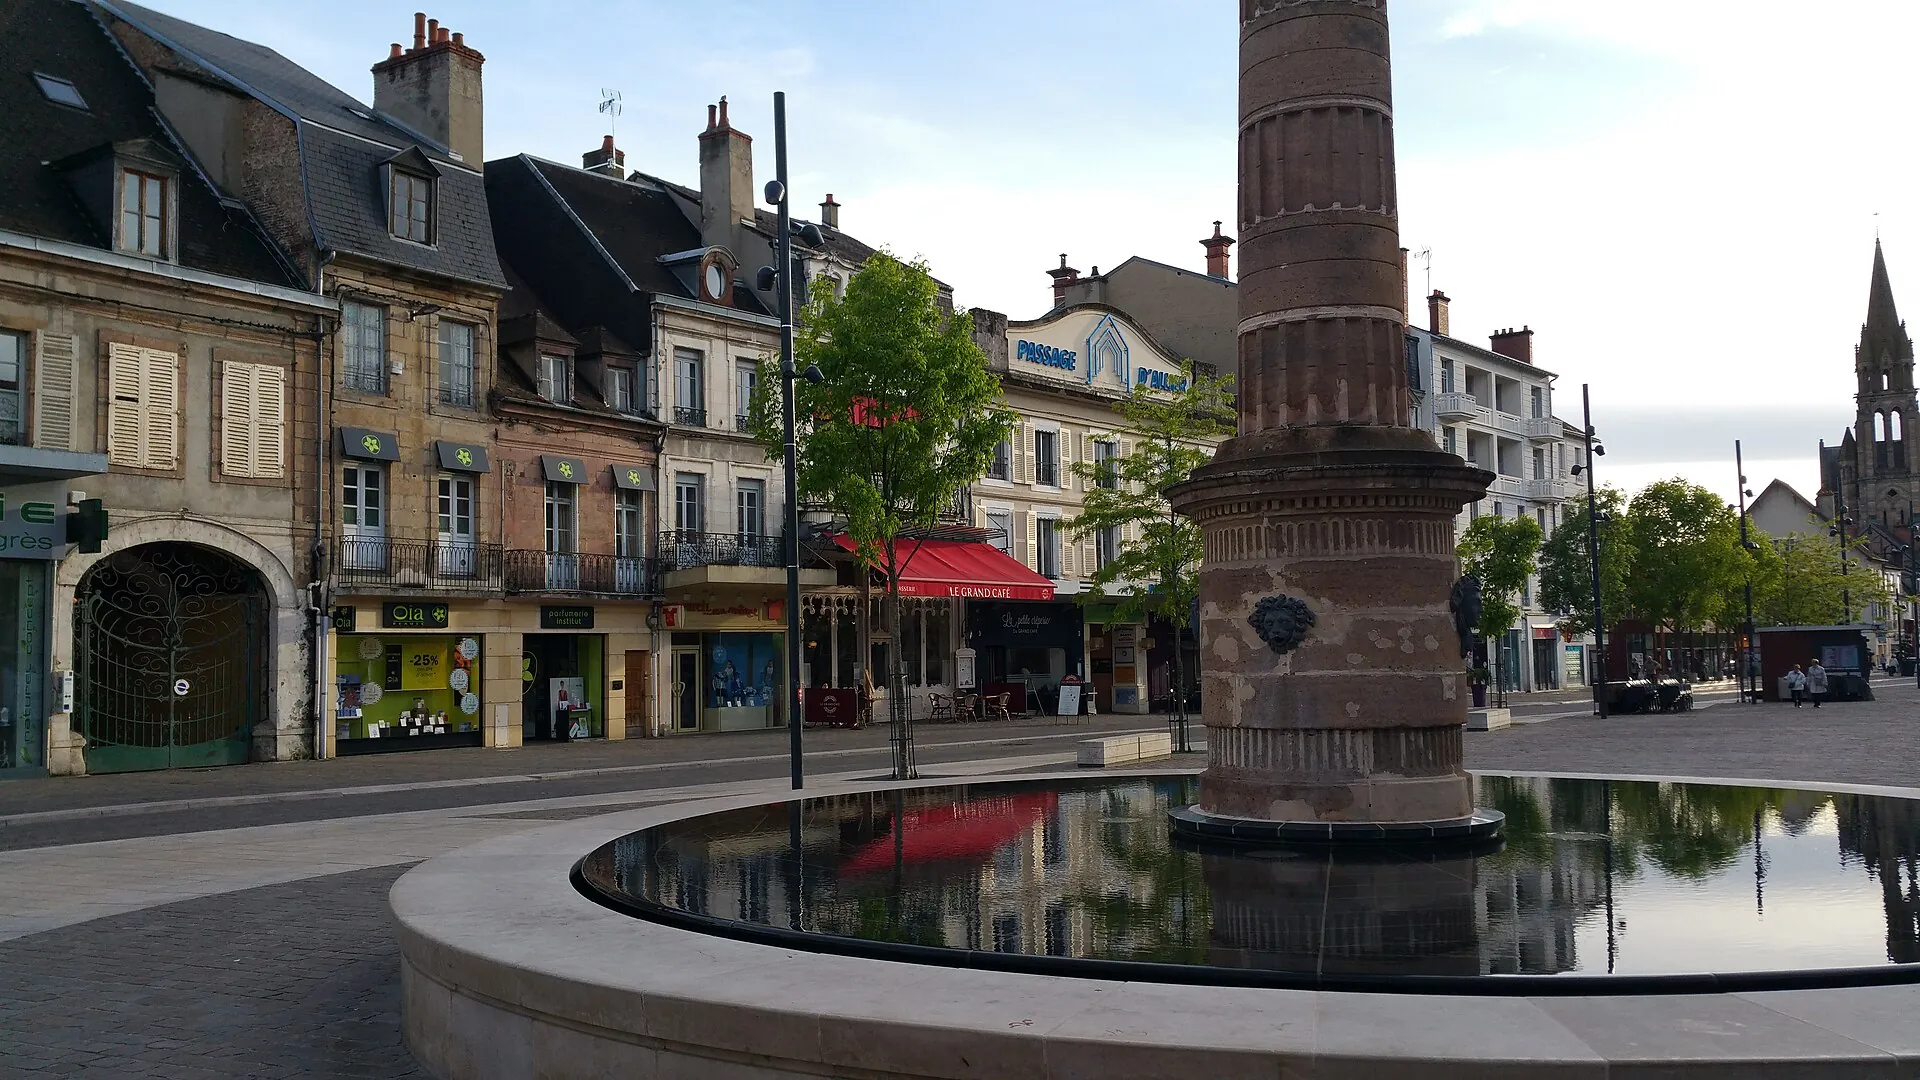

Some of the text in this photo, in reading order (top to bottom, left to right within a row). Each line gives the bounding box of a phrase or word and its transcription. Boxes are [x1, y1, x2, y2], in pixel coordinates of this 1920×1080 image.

[1017, 339, 1077, 371] PASSAGE
[0, 531, 53, 552] grès
[949, 586, 1011, 599] LE GRAND CAFÉ
[556, 617, 582, 625] institut
[409, 654, 439, 667] -25%
